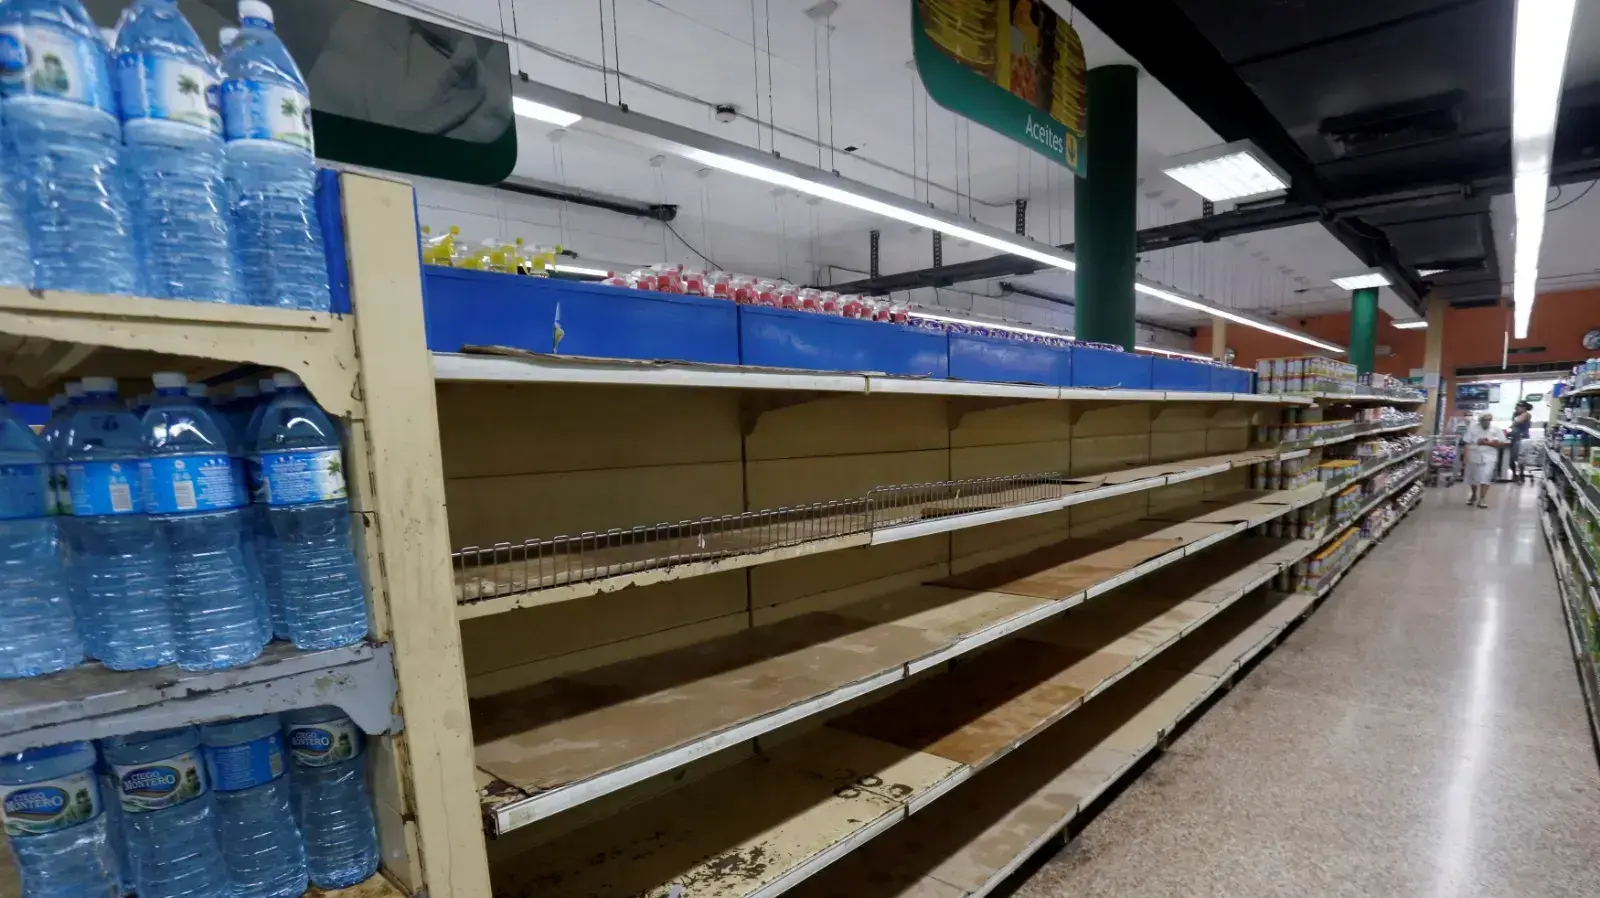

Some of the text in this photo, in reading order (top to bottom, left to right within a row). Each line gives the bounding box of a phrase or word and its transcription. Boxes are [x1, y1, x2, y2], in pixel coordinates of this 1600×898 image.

[1026, 113, 1063, 154] Aceites
[123, 775, 175, 791] MONTERO
[131, 771, 160, 780] CIEGO
